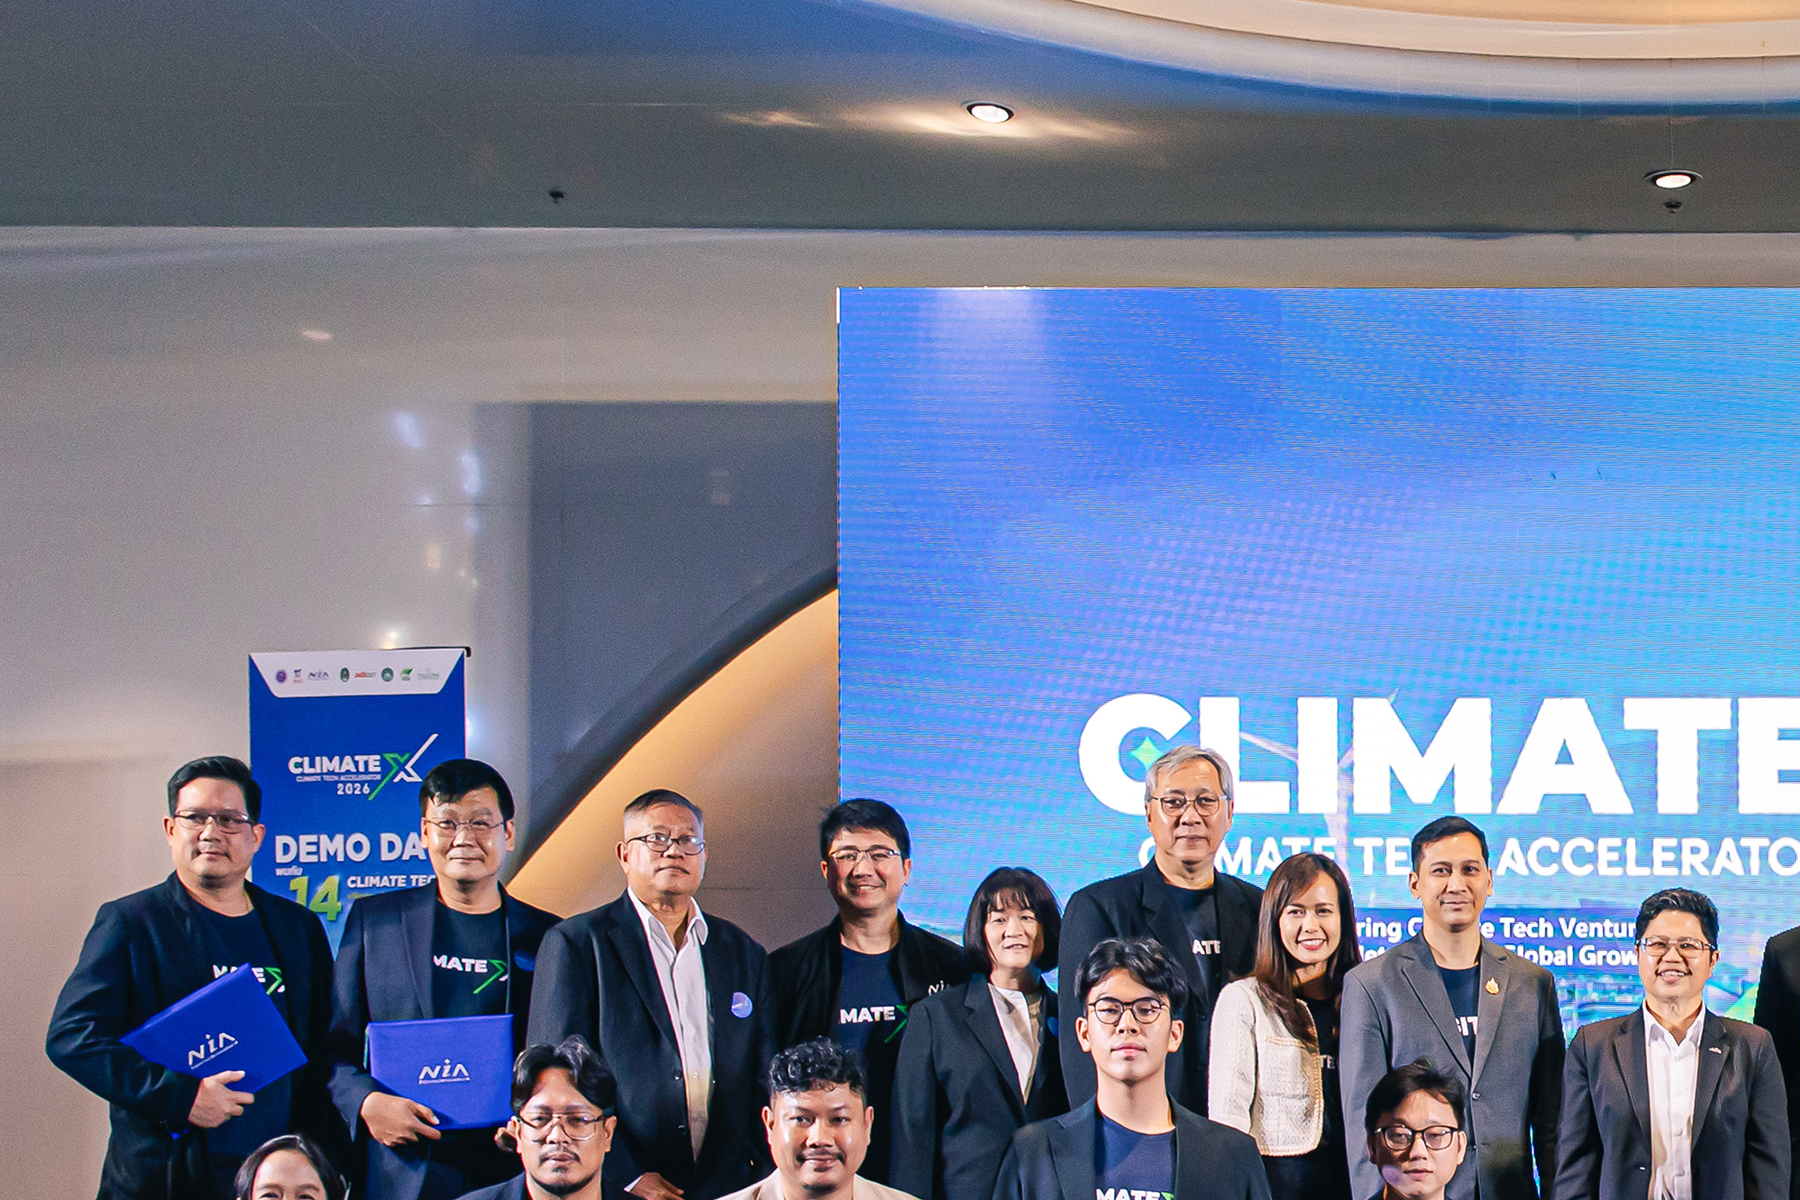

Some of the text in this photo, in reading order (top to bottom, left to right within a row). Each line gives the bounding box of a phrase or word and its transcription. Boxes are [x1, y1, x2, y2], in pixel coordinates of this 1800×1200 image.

[336, 782, 371, 796] 2026
[275, 832, 371, 864] DEMO
[346, 875, 407, 888] CLIMATE
[289, 874, 342, 921] 14
[1499, 917, 1554, 938] Tech
